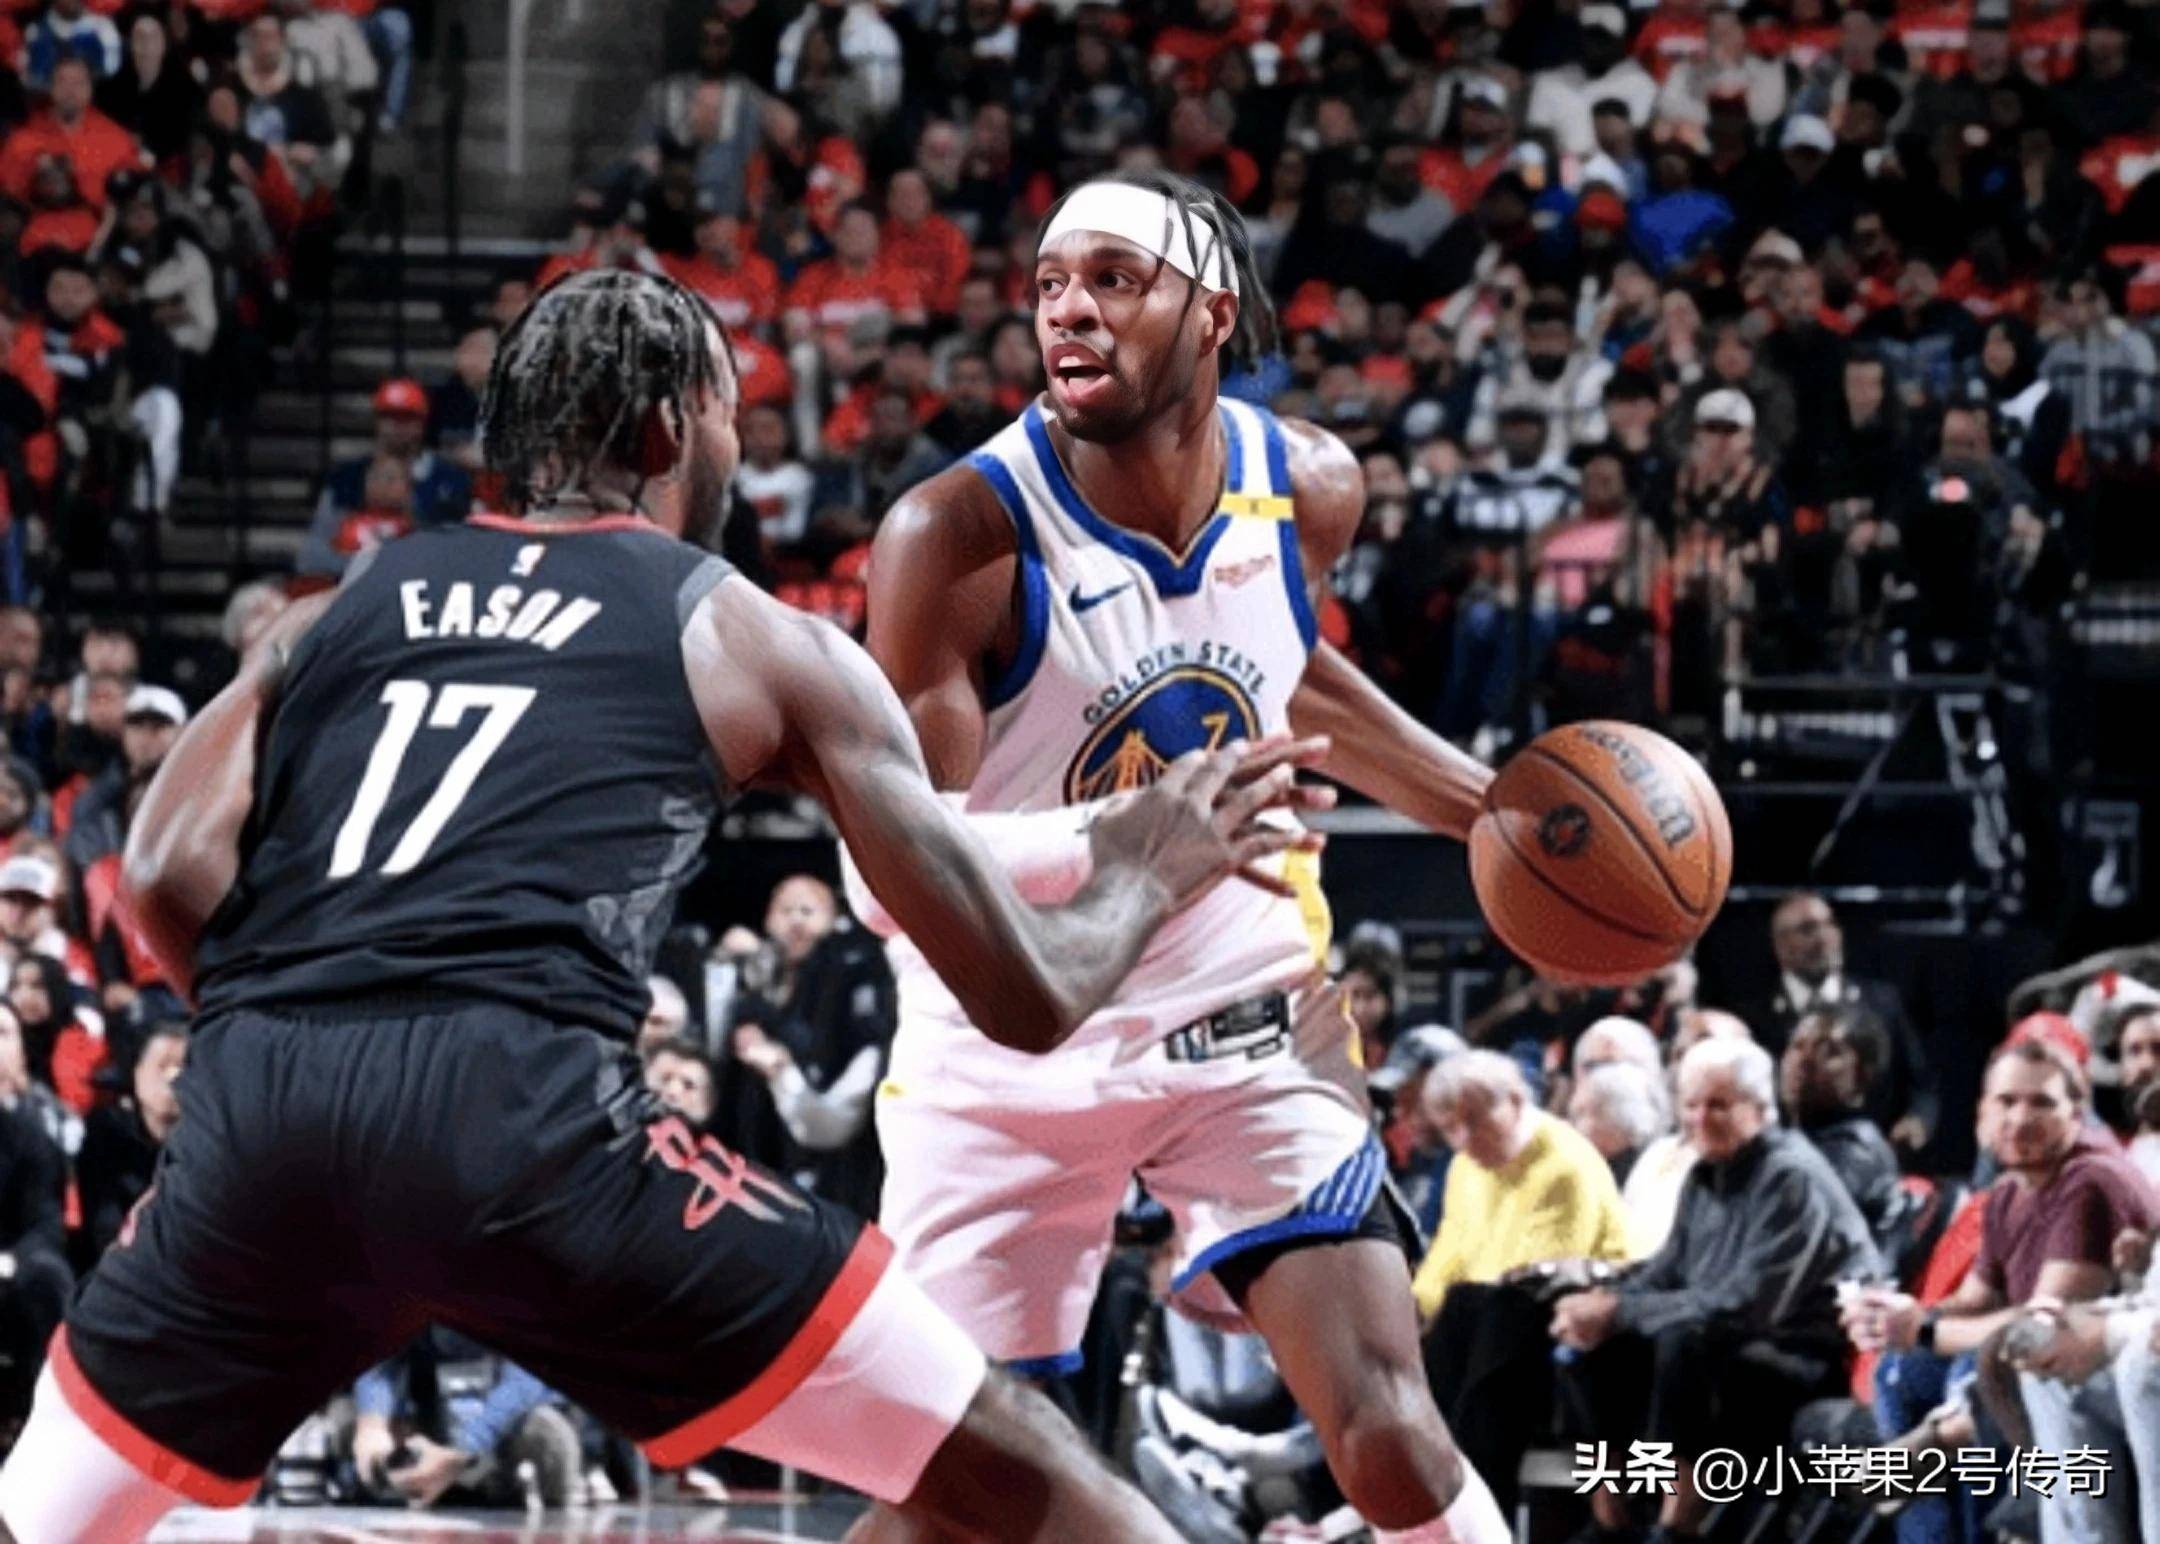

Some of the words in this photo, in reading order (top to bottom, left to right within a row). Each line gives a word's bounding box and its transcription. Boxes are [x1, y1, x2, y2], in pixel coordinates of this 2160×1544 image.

[400, 579, 602, 651] EASON
[1083, 643, 1186, 724] GOLDEN
[1199, 640, 1265, 694] STATE
[327, 679, 538, 879] 17
